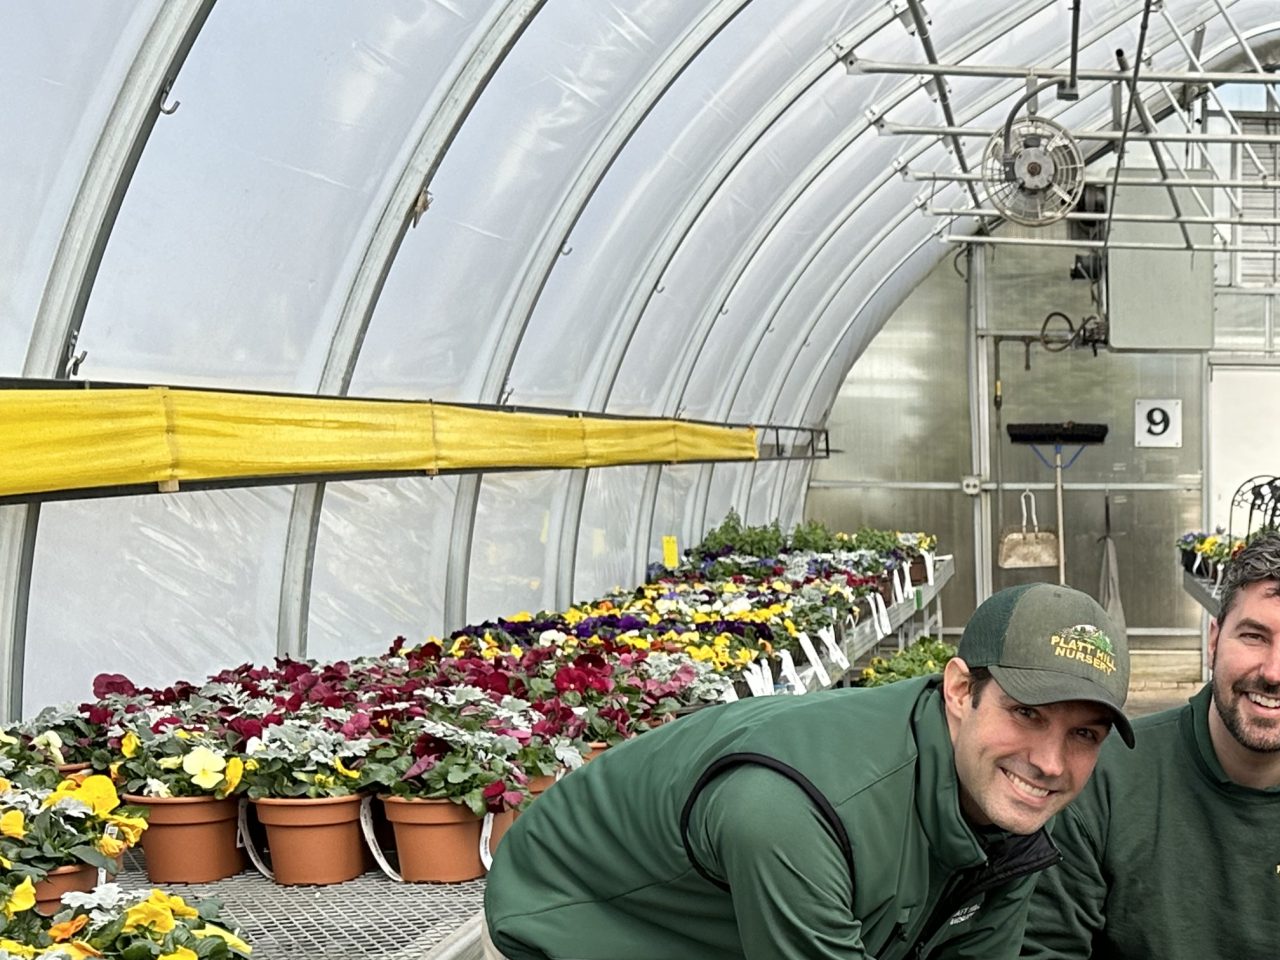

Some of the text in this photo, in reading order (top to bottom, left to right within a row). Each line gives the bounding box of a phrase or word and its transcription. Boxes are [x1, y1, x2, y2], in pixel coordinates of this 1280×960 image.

[1146, 407, 1170, 436] 9
[1050, 635, 1117, 672] PLATT HILL
[1054, 647, 1113, 676] NURSERY
